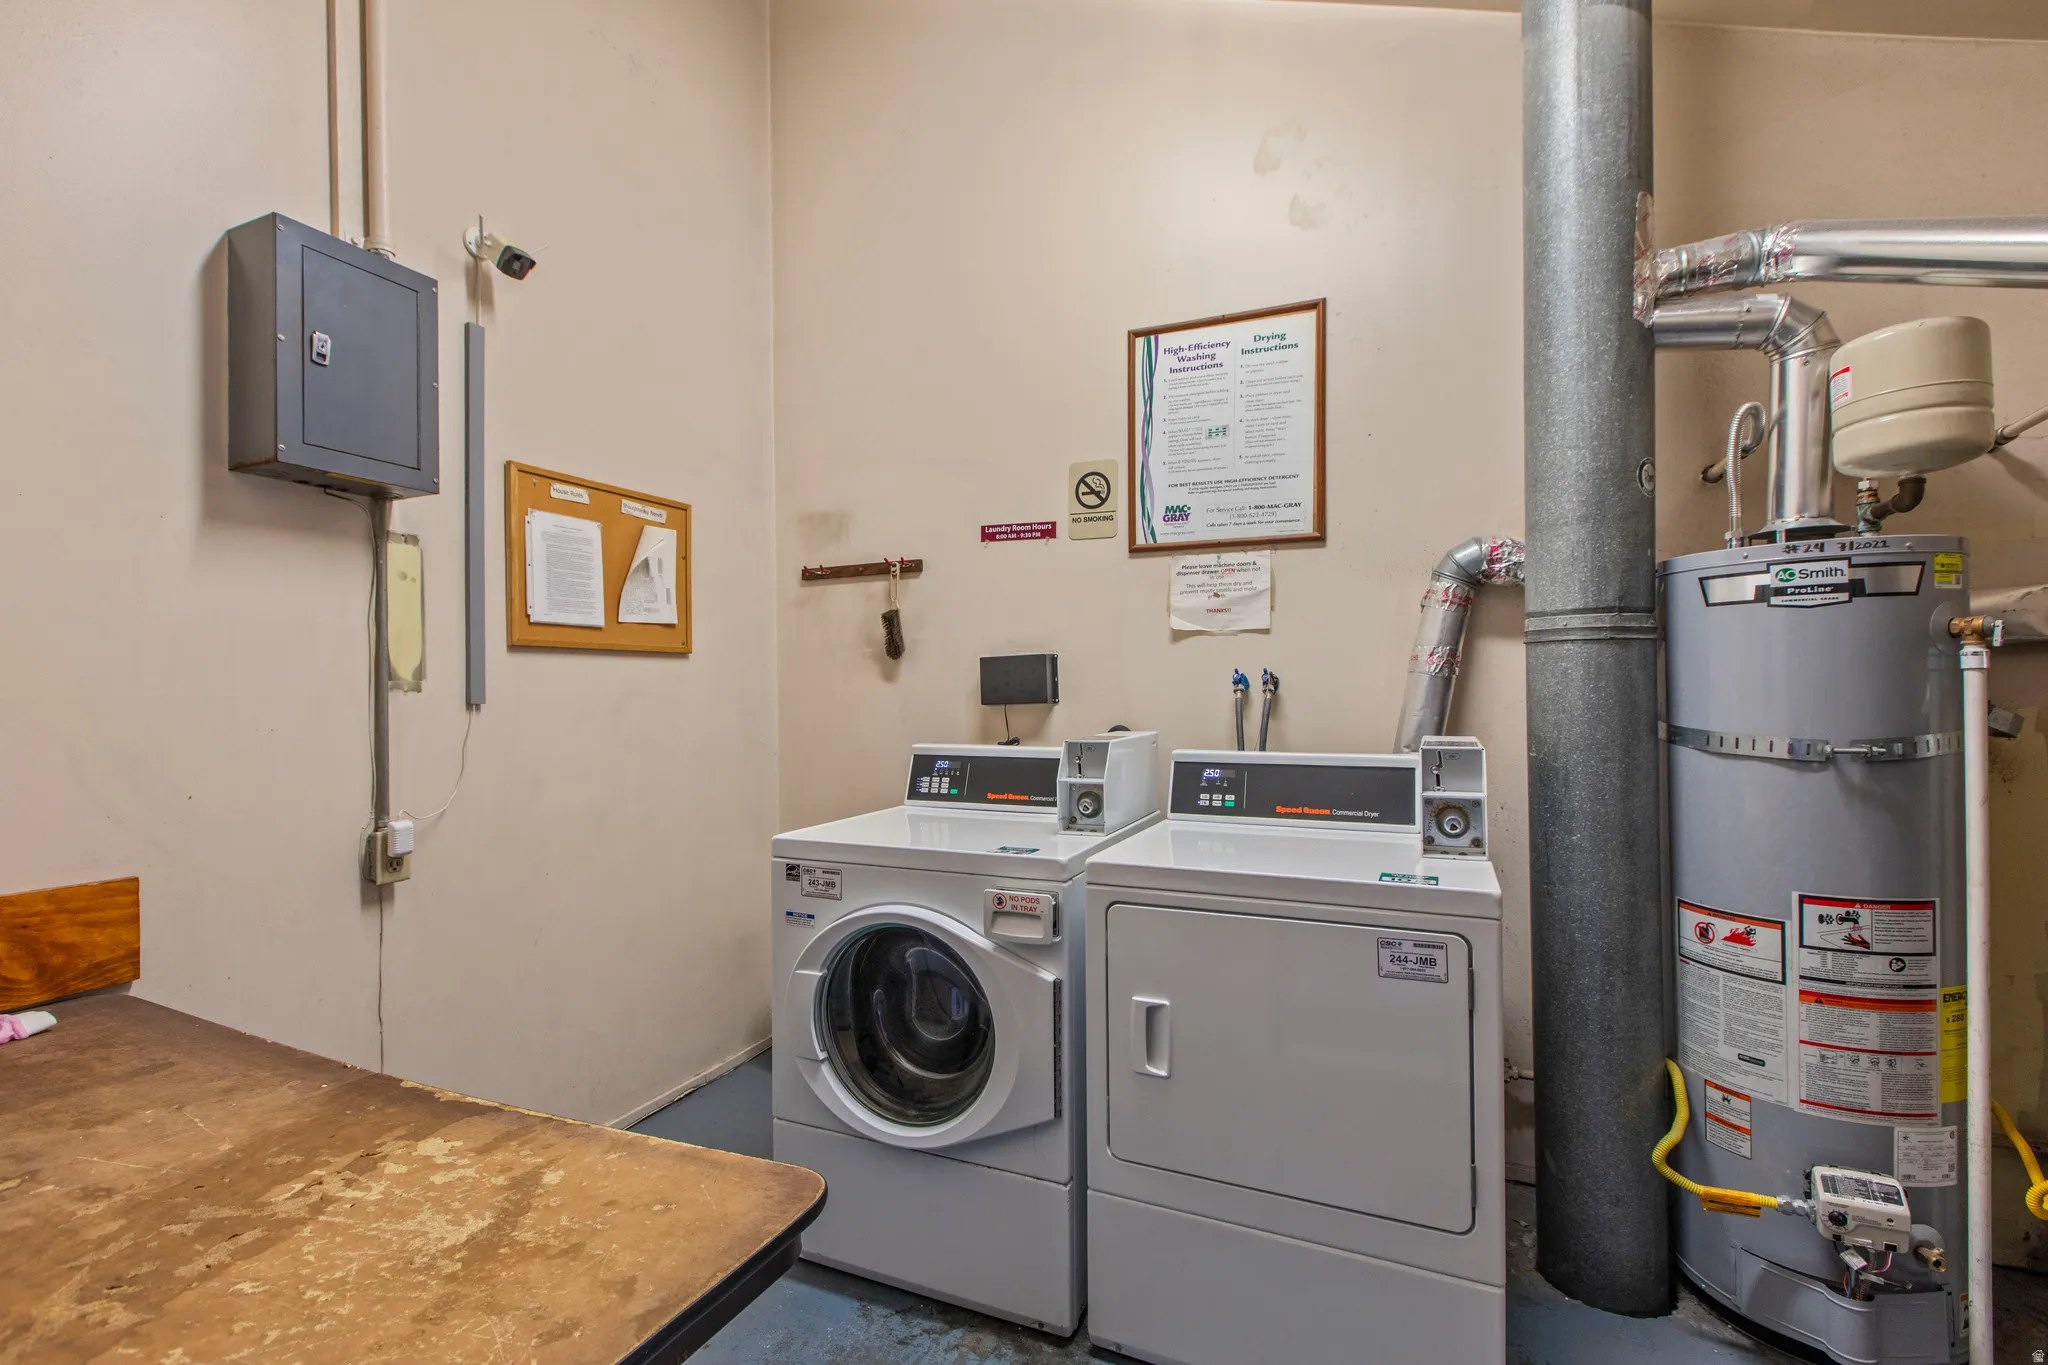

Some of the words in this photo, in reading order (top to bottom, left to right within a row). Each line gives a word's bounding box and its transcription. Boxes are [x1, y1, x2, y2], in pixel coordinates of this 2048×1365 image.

[1254, 331, 1286, 343] Drying
[1164, 340, 1231, 356] High-Efficiency
[1241, 342, 1298, 356] Instructions
[1177, 352, 1216, 364] Washing
[1169, 362, 1223, 374] Instructions
[552, 487, 569, 496] House
[1248, 502, 1302, 510] 1-800-MAC-GRAY
[650, 510, 663, 518] News
[1163, 513, 1191, 522] GRAY
[1229, 512, 1277, 521] (1-800-622-4729)
[1083, 515, 1114, 523] SMOKING
[985, 526, 1011, 534] Laundry
[1787, 586, 1832, 594] ProLine
[987, 793, 1007, 801] Speed
[1276, 805, 1302, 815] Speed
[1303, 807, 1331, 815] Queen
[1332, 808, 1363, 817] Commercial
[808, 879, 836, 888] 243-JMB
[1021, 896, 1040, 904] PODS
[1020, 905, 1038, 913] TRAY
[1390, 954, 1437, 967] 244-JMB
